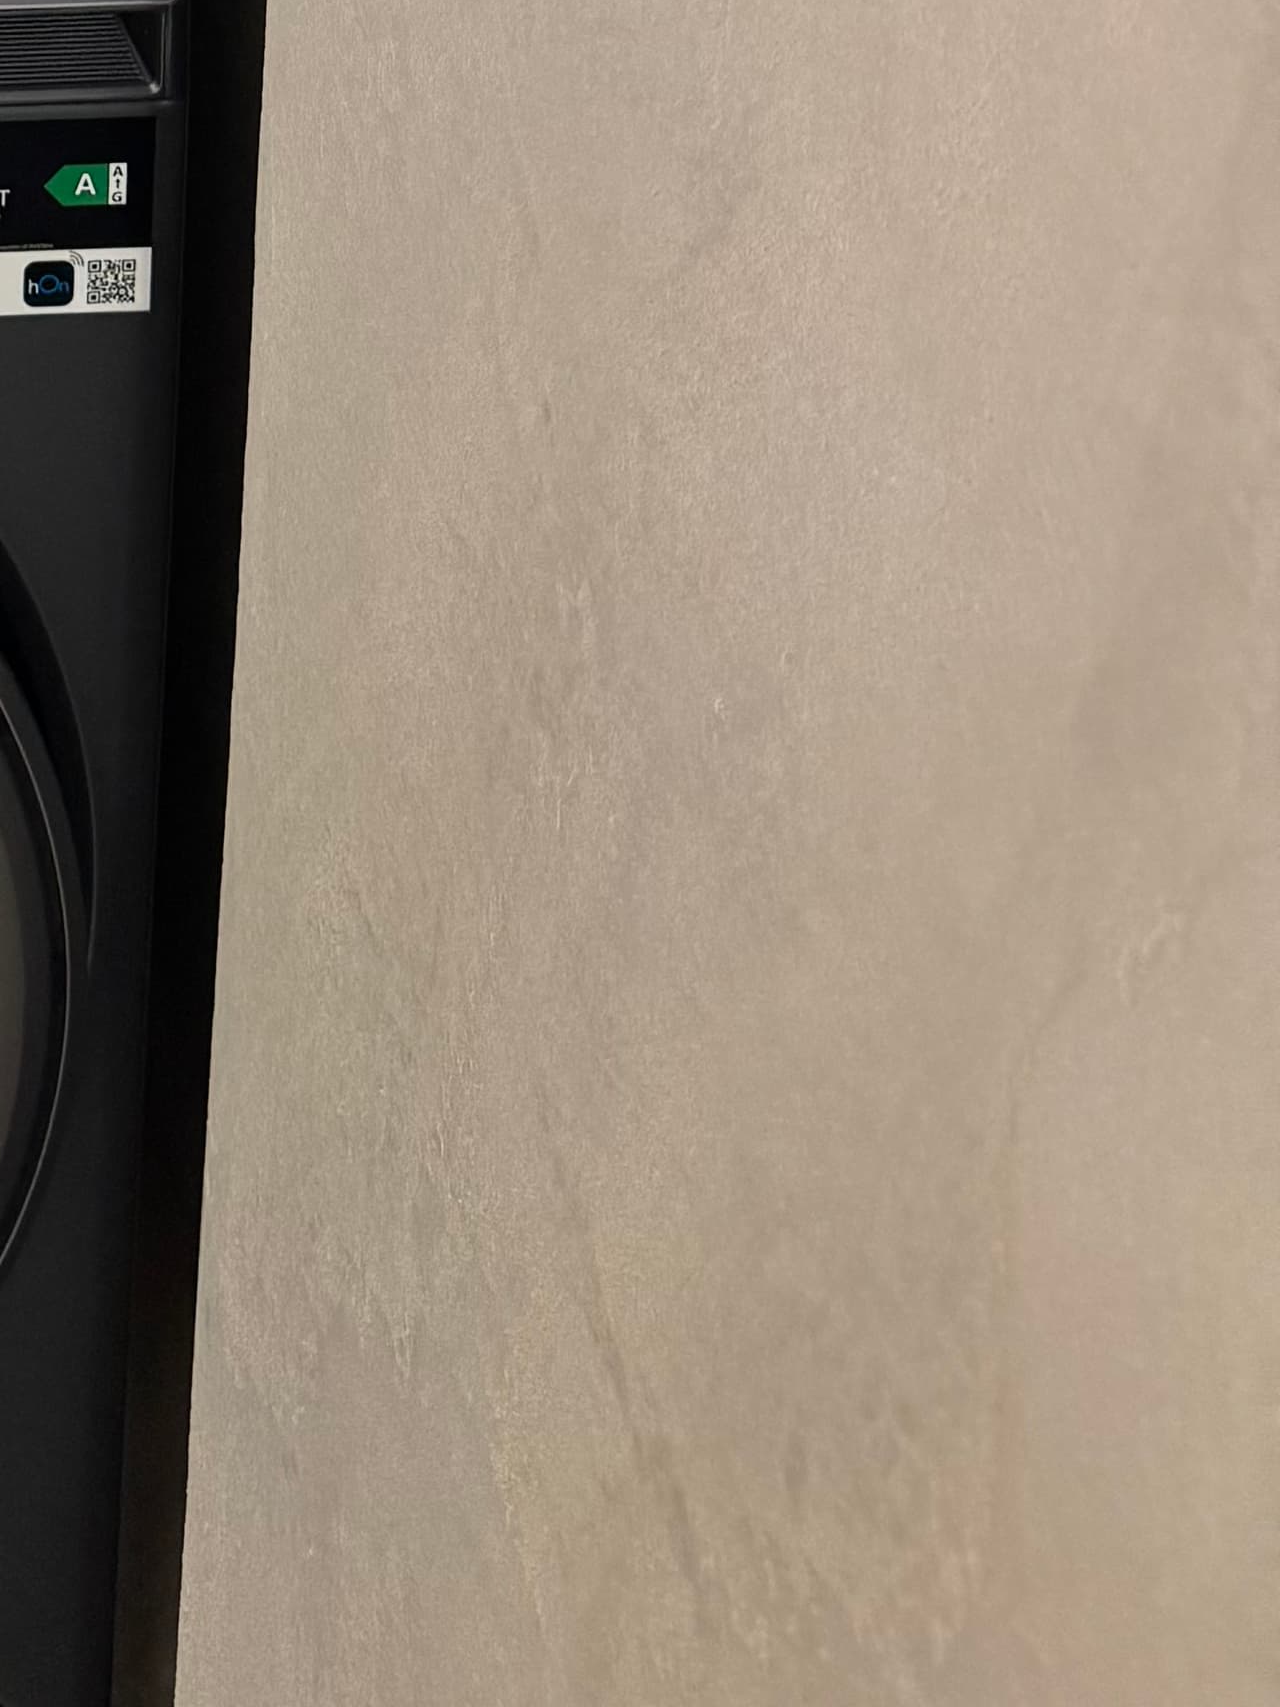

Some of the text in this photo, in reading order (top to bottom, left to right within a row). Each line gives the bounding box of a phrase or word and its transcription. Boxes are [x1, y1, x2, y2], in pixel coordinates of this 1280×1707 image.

[113, 165, 124, 177] A
[74, 173, 97, 196] A
[111, 191, 123, 203] G
[28, 274, 70, 295] hOn
